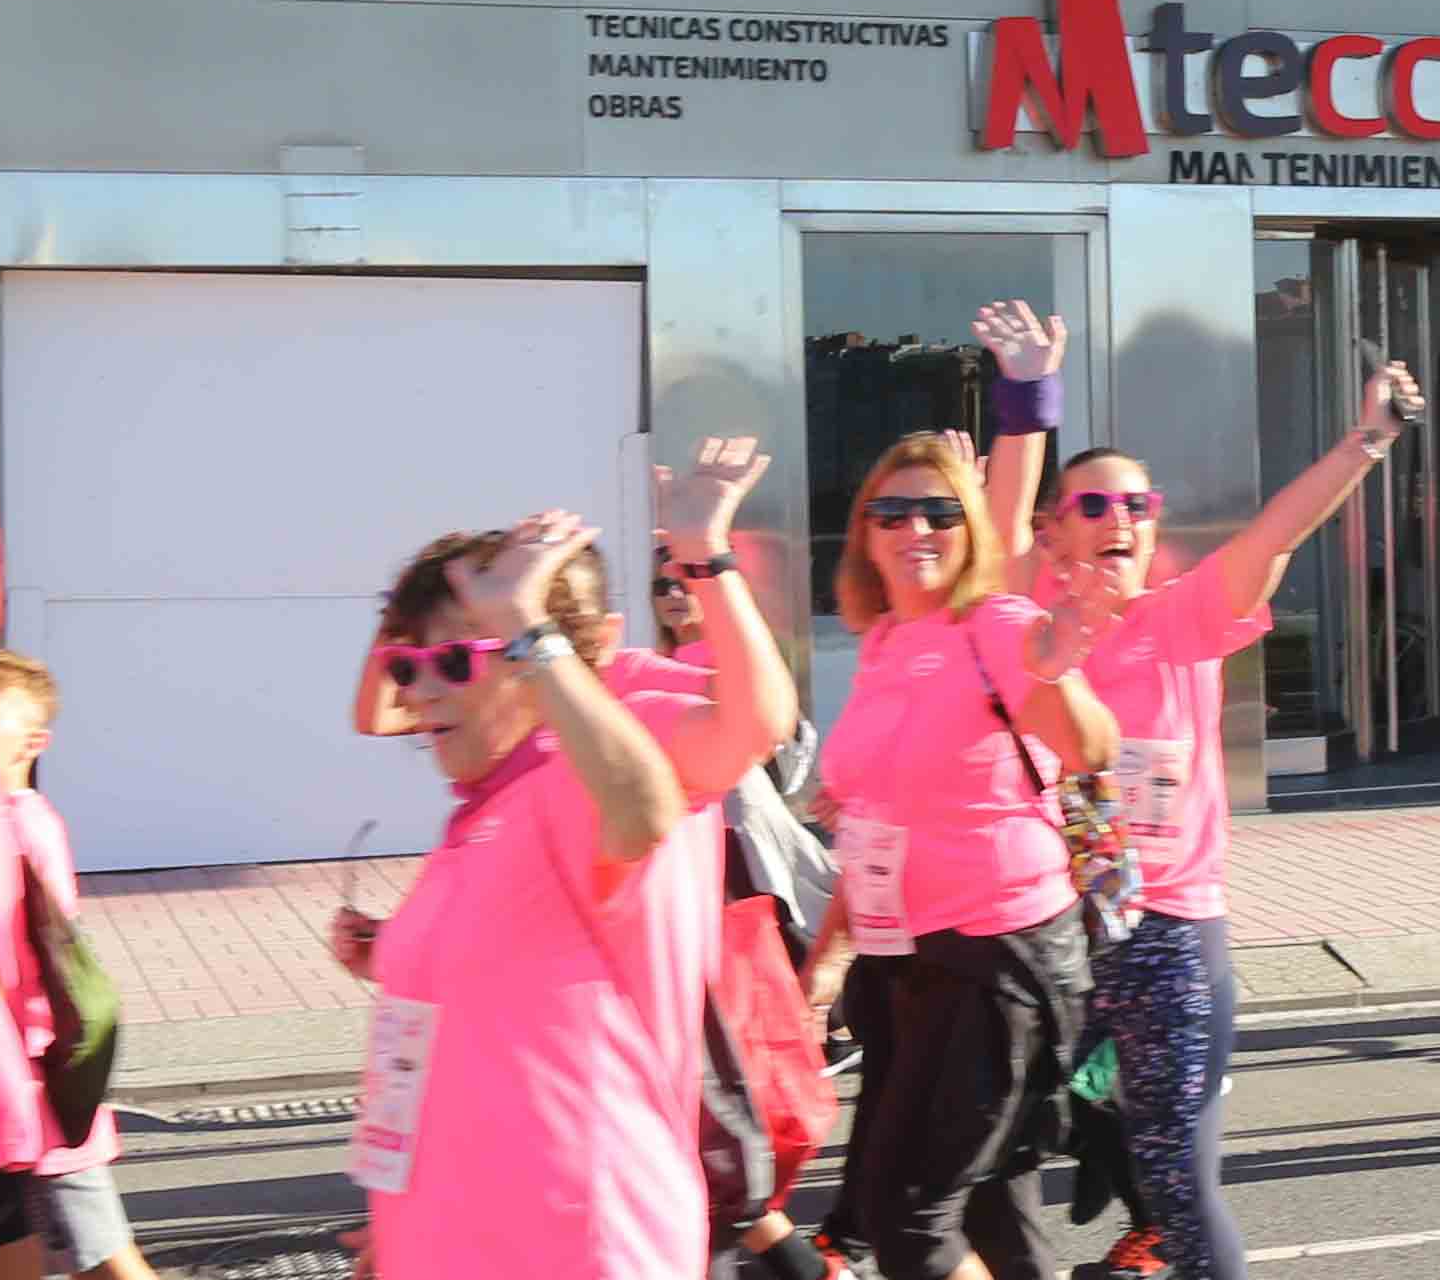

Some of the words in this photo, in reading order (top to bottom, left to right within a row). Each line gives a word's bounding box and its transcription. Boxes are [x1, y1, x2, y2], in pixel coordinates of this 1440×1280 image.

[586, 14, 721, 41] TECNICAS
[728, 17, 950, 47] CONSTRUCTIVAS
[588, 53, 829, 82] MANTENIMIENTO
[588, 93, 683, 119] OBRAS
